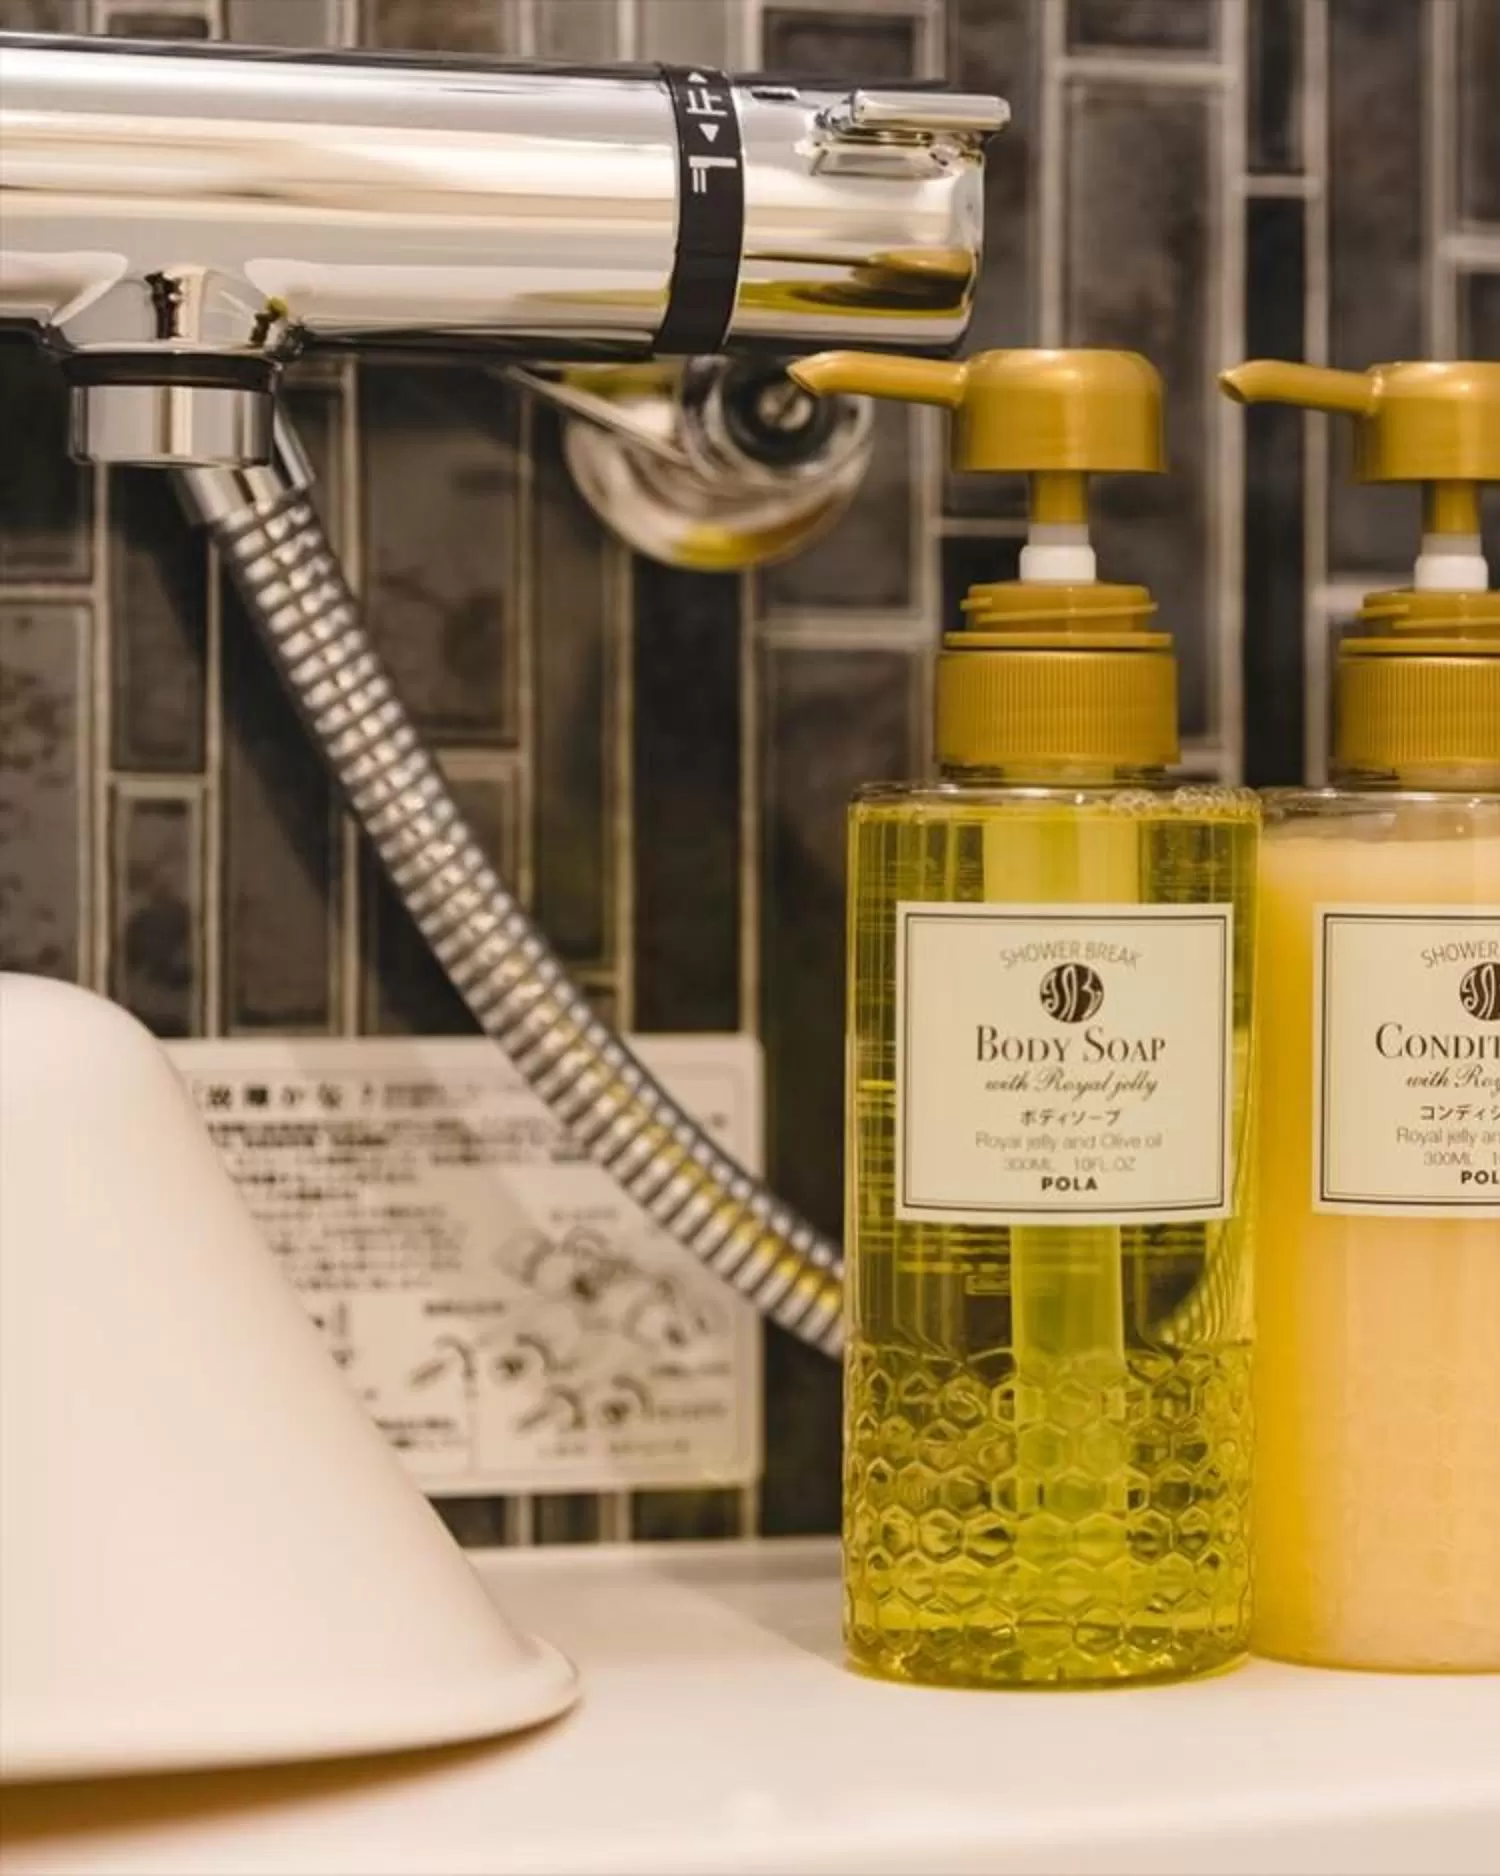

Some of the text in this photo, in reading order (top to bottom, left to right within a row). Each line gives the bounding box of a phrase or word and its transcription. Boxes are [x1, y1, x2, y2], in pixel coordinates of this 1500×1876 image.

[1000, 940, 1144, 971] SHOWER BREAK
[1421, 940, 1498, 968] SHOWER
[985, 1067, 1160, 1101] with Royal jelly
[1405, 1068, 1449, 1089] with
[975, 1131, 1163, 1152] Royal jelly and Olive oil
[1396, 1127, 1443, 1146] Royal
[1447, 1128, 1478, 1148] jelly
[1004, 1156, 1055, 1172] 300ML
[1424, 1151, 1472, 1166] 300ML
[1041, 1176, 1098, 1192] POLA
